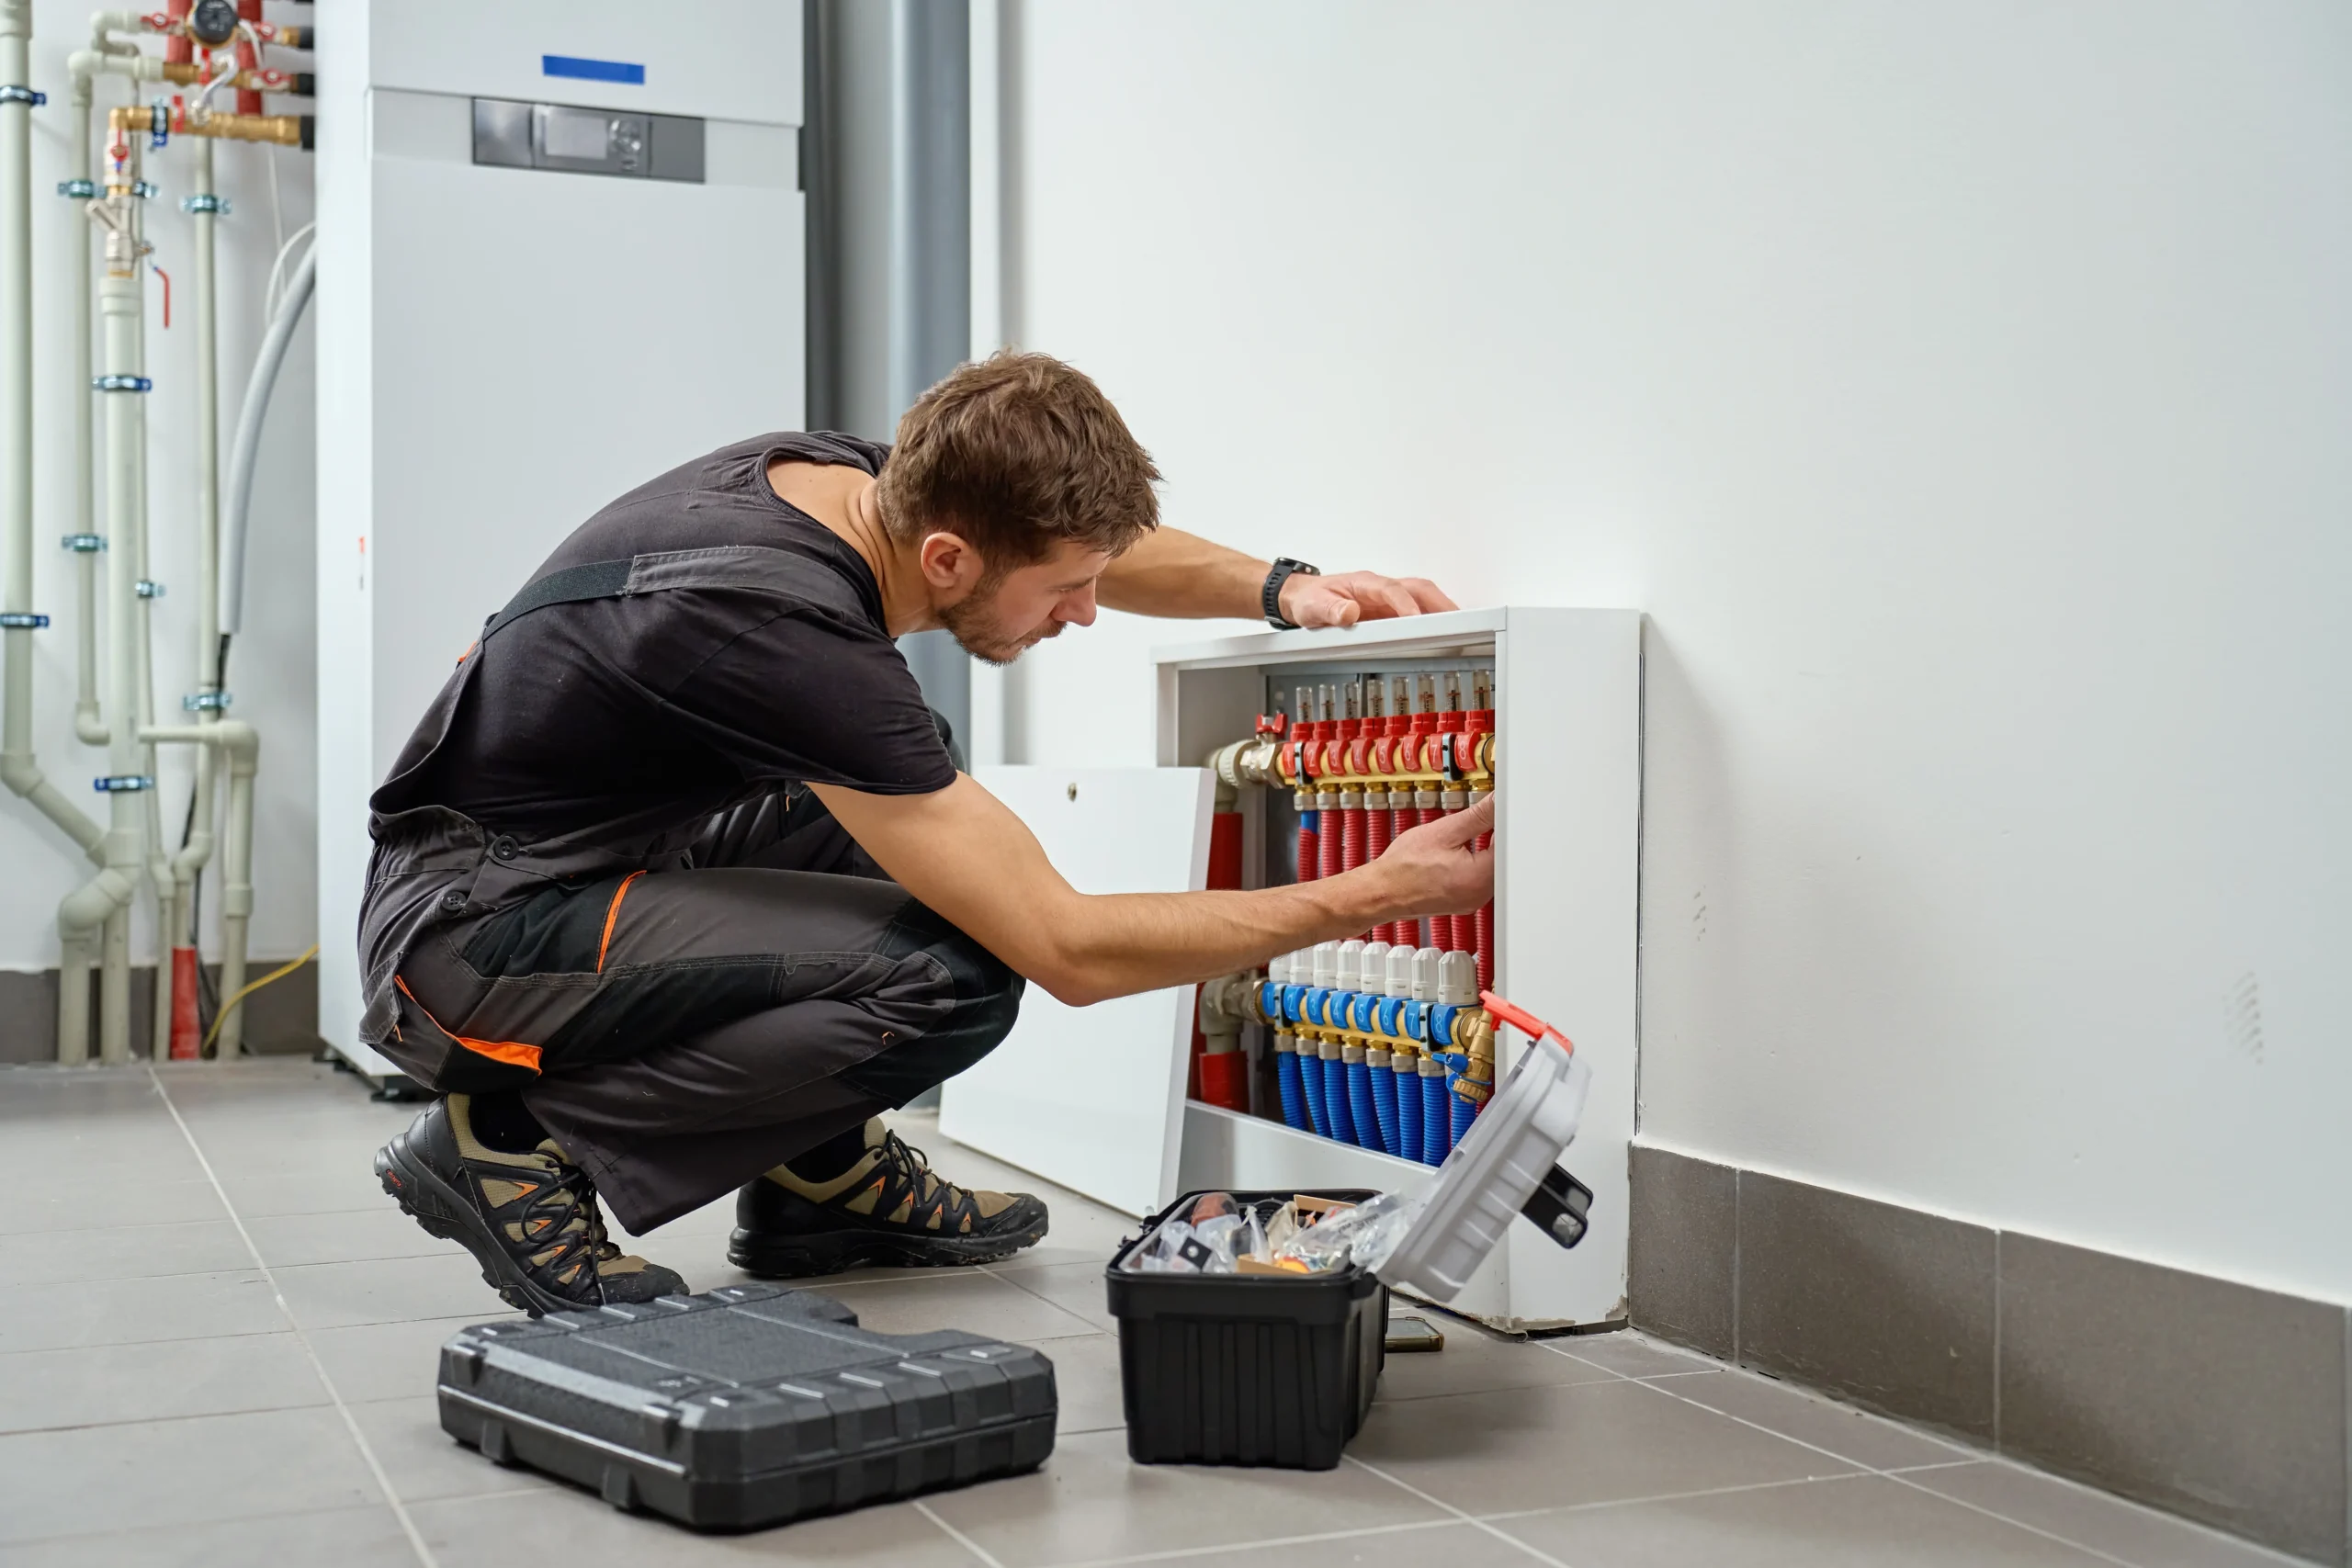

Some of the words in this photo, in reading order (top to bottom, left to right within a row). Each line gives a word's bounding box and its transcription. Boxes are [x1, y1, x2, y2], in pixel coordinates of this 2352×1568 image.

[1307, 750, 1316, 767] 2
[1330, 750, 1339, 767] 3
[1354, 748, 1362, 765] 4
[1379, 745, 1386, 763] 5
[1404, 743, 1410, 761] 6
[1431, 744, 1438, 762] 7
[1459, 740, 1466, 760] 8
[1287, 994, 1294, 1011] 2
[1310, 998, 1317, 1016] 3
[1333, 1002, 1340, 1020] 4
[1358, 1004, 1364, 1022] 5
[1383, 1007, 1389, 1026] 6
[1408, 1013, 1415, 1031] 7
[1435, 1014, 1442, 1033] 8
